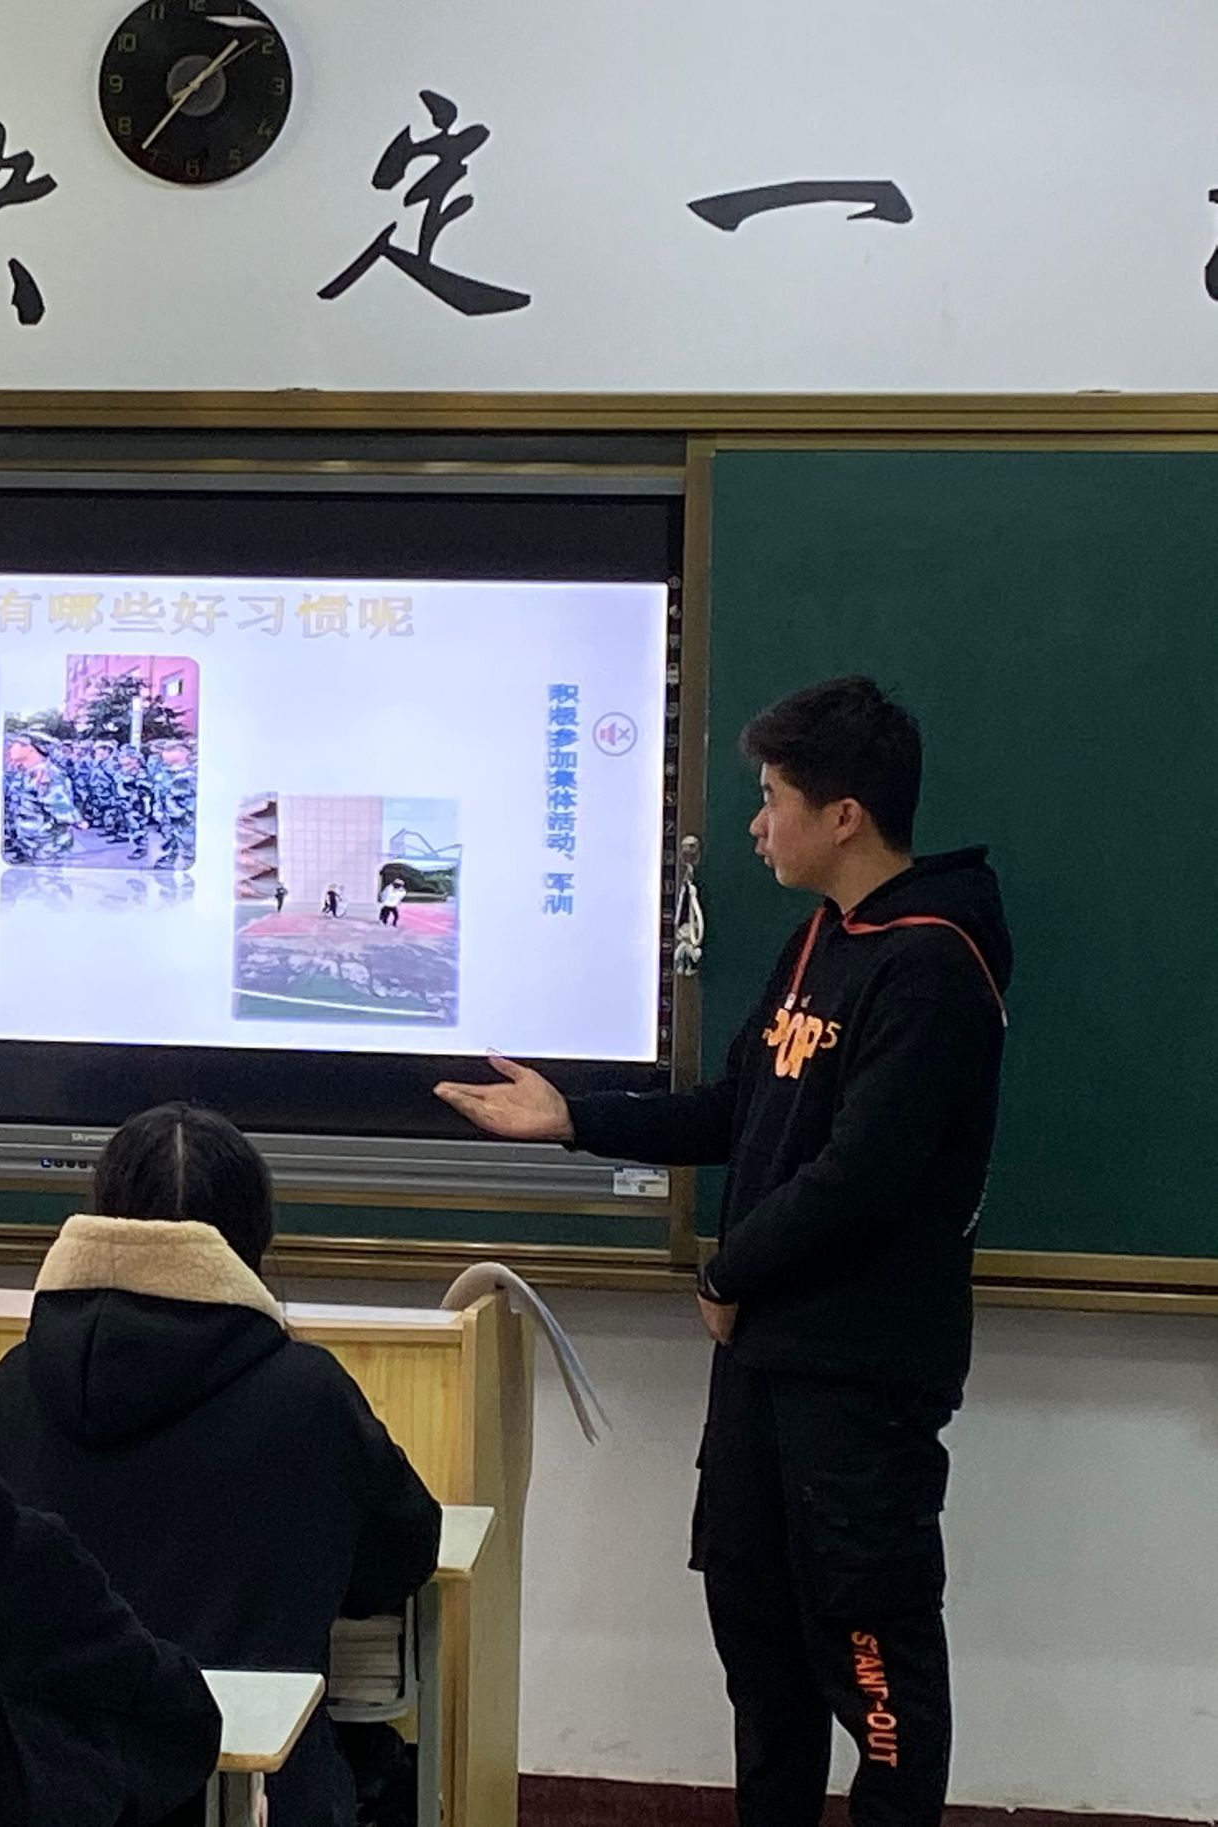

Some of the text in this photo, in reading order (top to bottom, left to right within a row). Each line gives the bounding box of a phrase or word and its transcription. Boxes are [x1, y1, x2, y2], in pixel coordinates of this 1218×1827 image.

[150, 3, 165, 20] 11
[117, 33, 137, 52] 10
[261, 33, 276, 54] 2
[108, 74, 124, 94] 9
[271, 76, 286, 96] 3
[117, 116, 132, 136] 8
